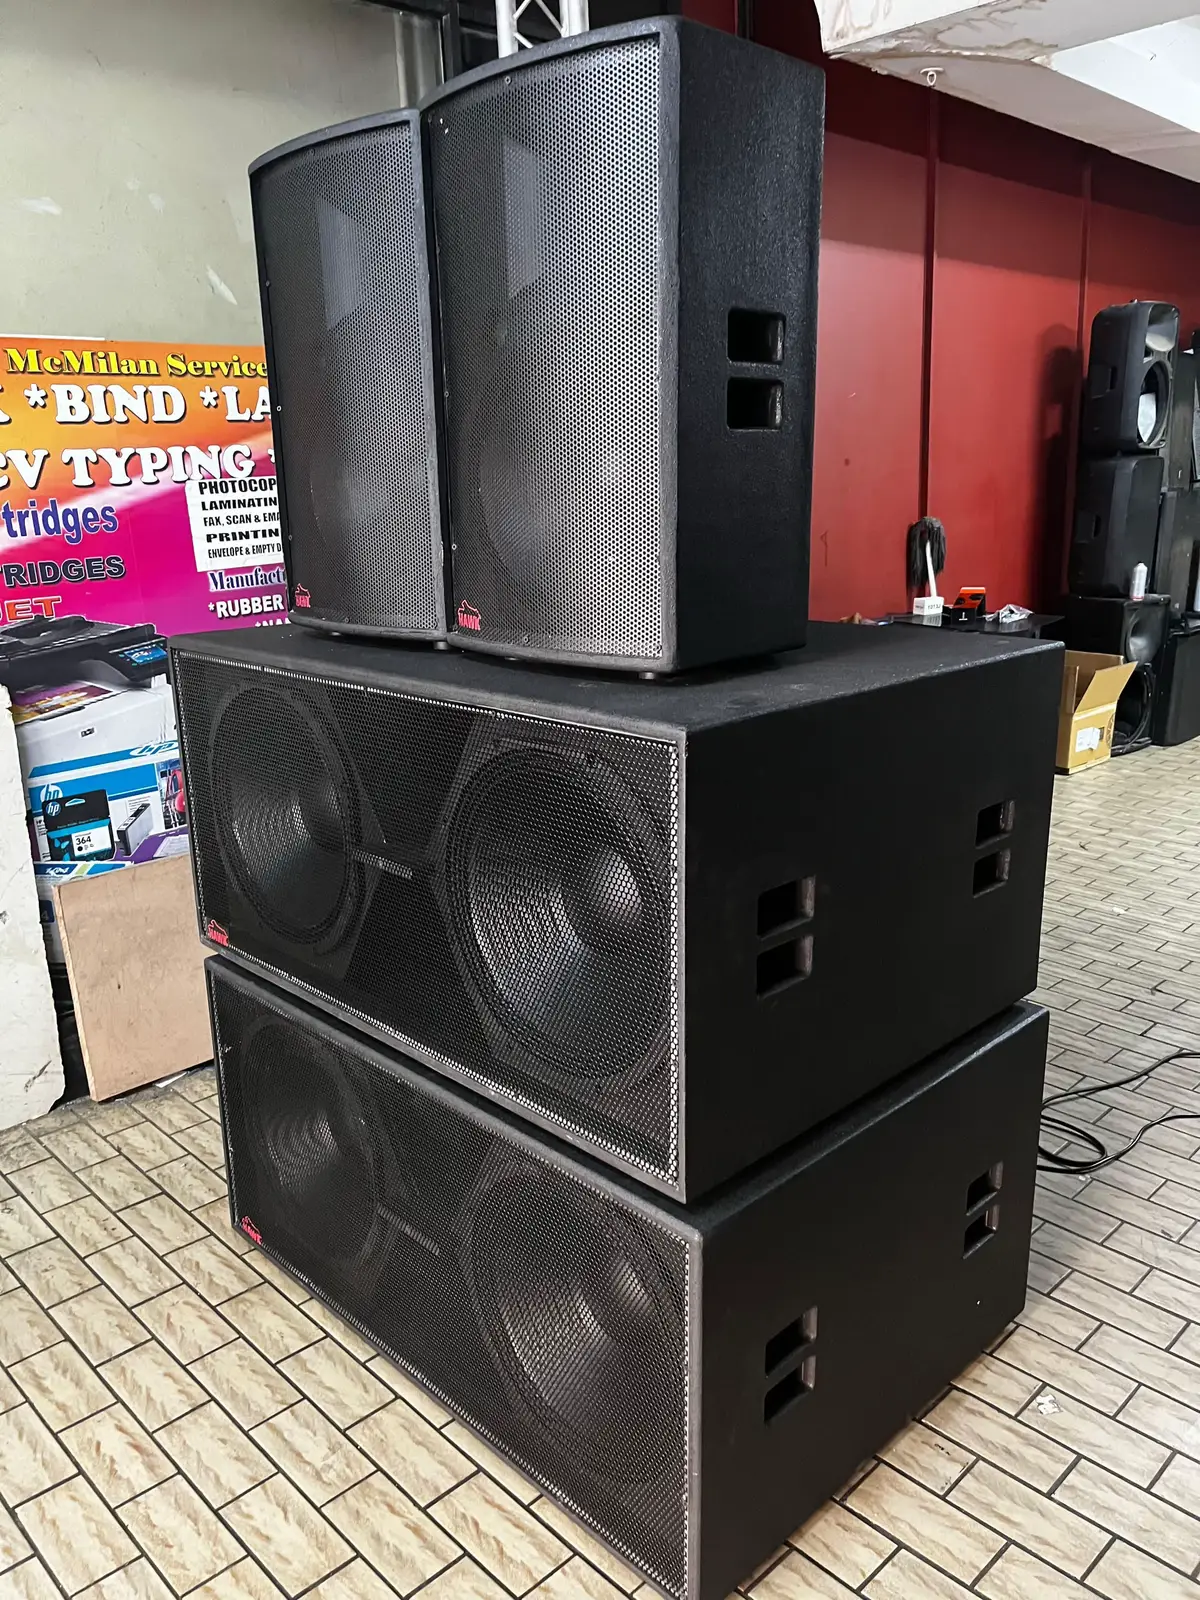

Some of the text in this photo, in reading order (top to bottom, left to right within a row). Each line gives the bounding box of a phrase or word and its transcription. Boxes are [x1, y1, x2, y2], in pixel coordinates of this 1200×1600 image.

[6, 348, 160, 376] McMilan
[0, 445, 256, 489] V TYPING
[199, 478, 276, 495] PHOTOCOP
[201, 497, 277, 511] LAMINATIN
[2, 499, 118, 545] tridges
[203, 516, 224, 527] FAX,
[226, 514, 251, 525] SCAN
[254, 514, 261, 523] &
[206, 528, 279, 543] PRINTIN
[208, 546, 243, 559] ENVELOPE
[245, 547, 250, 555] &
[252, 543, 275, 554] EMPTY
[0, 556, 125, 588] RIDGES
[0, 596, 62, 622] ET
[76, 836, 92, 845] 364
